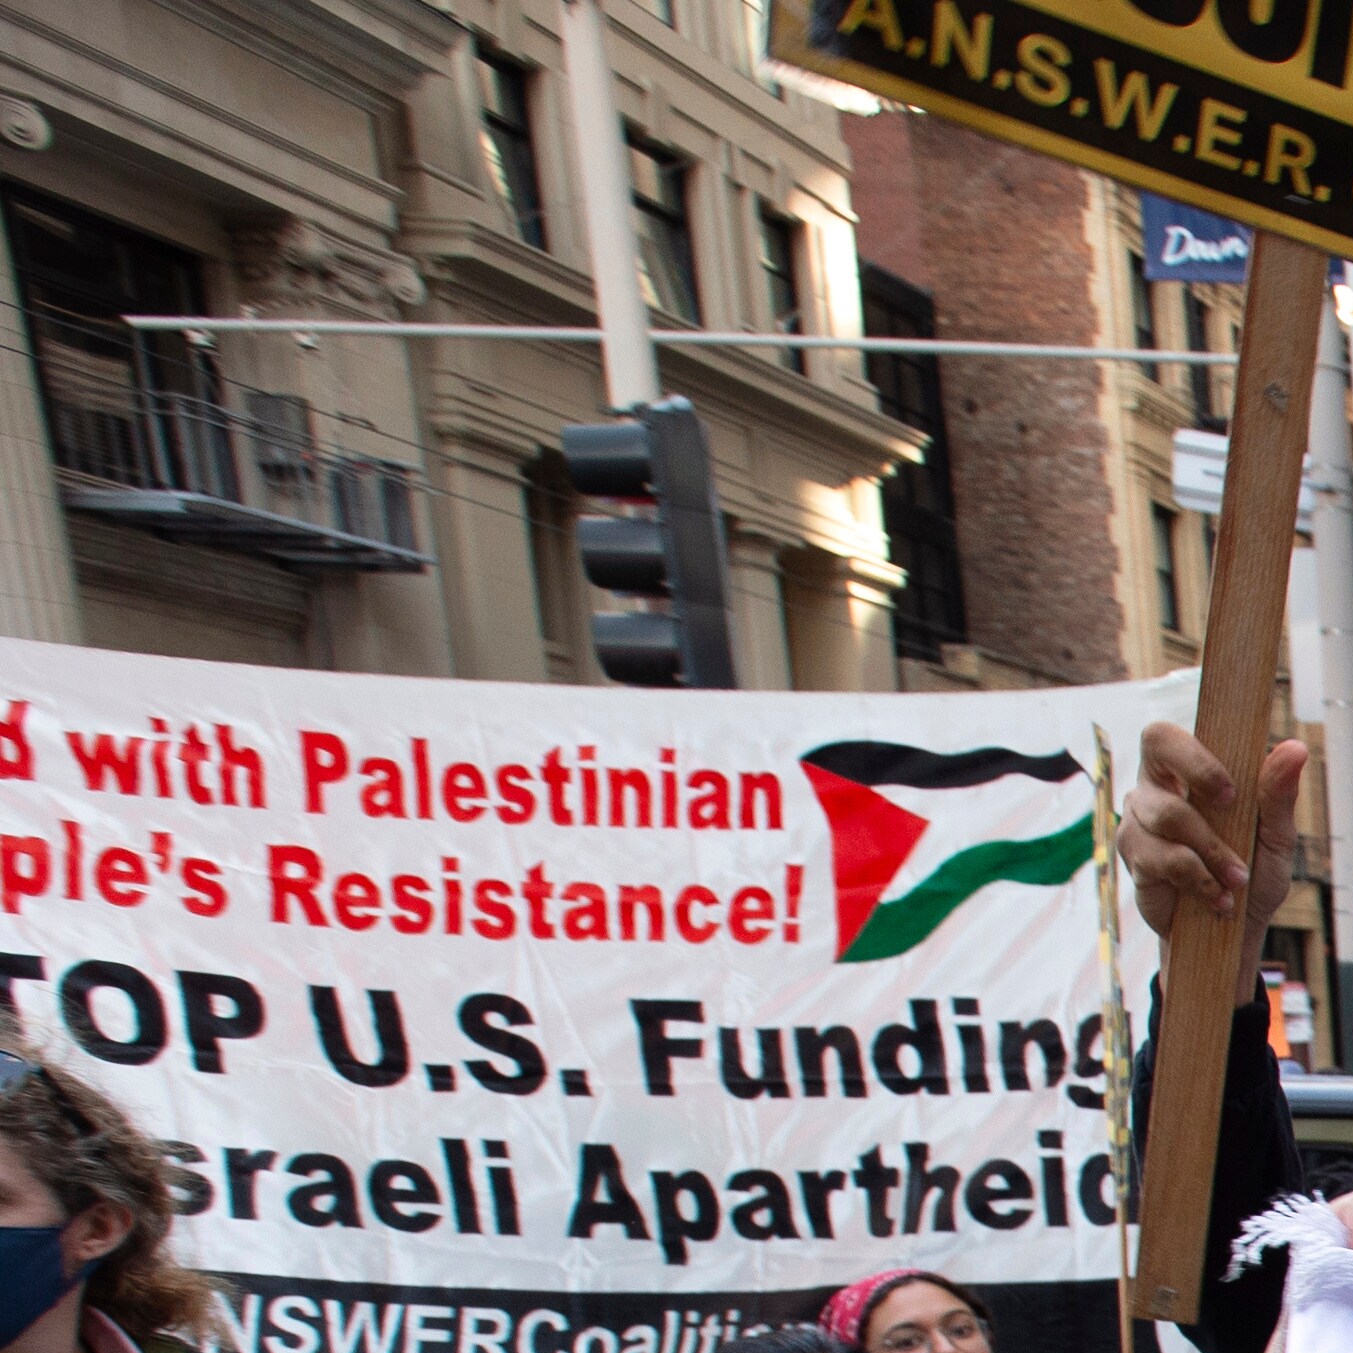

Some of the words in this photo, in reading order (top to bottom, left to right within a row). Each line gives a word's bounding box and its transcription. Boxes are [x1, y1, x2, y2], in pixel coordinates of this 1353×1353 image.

[836, 0, 1331, 201] A.N.S.W.E.R.
[66, 717, 267, 808] with
[300, 730, 783, 831] Palestinian
[267, 842, 803, 945] Resistance!
[310, 984, 592, 1098] U.S.
[631, 999, 1132, 1111] Funding
[165, 1137, 520, 1238] sraeli
